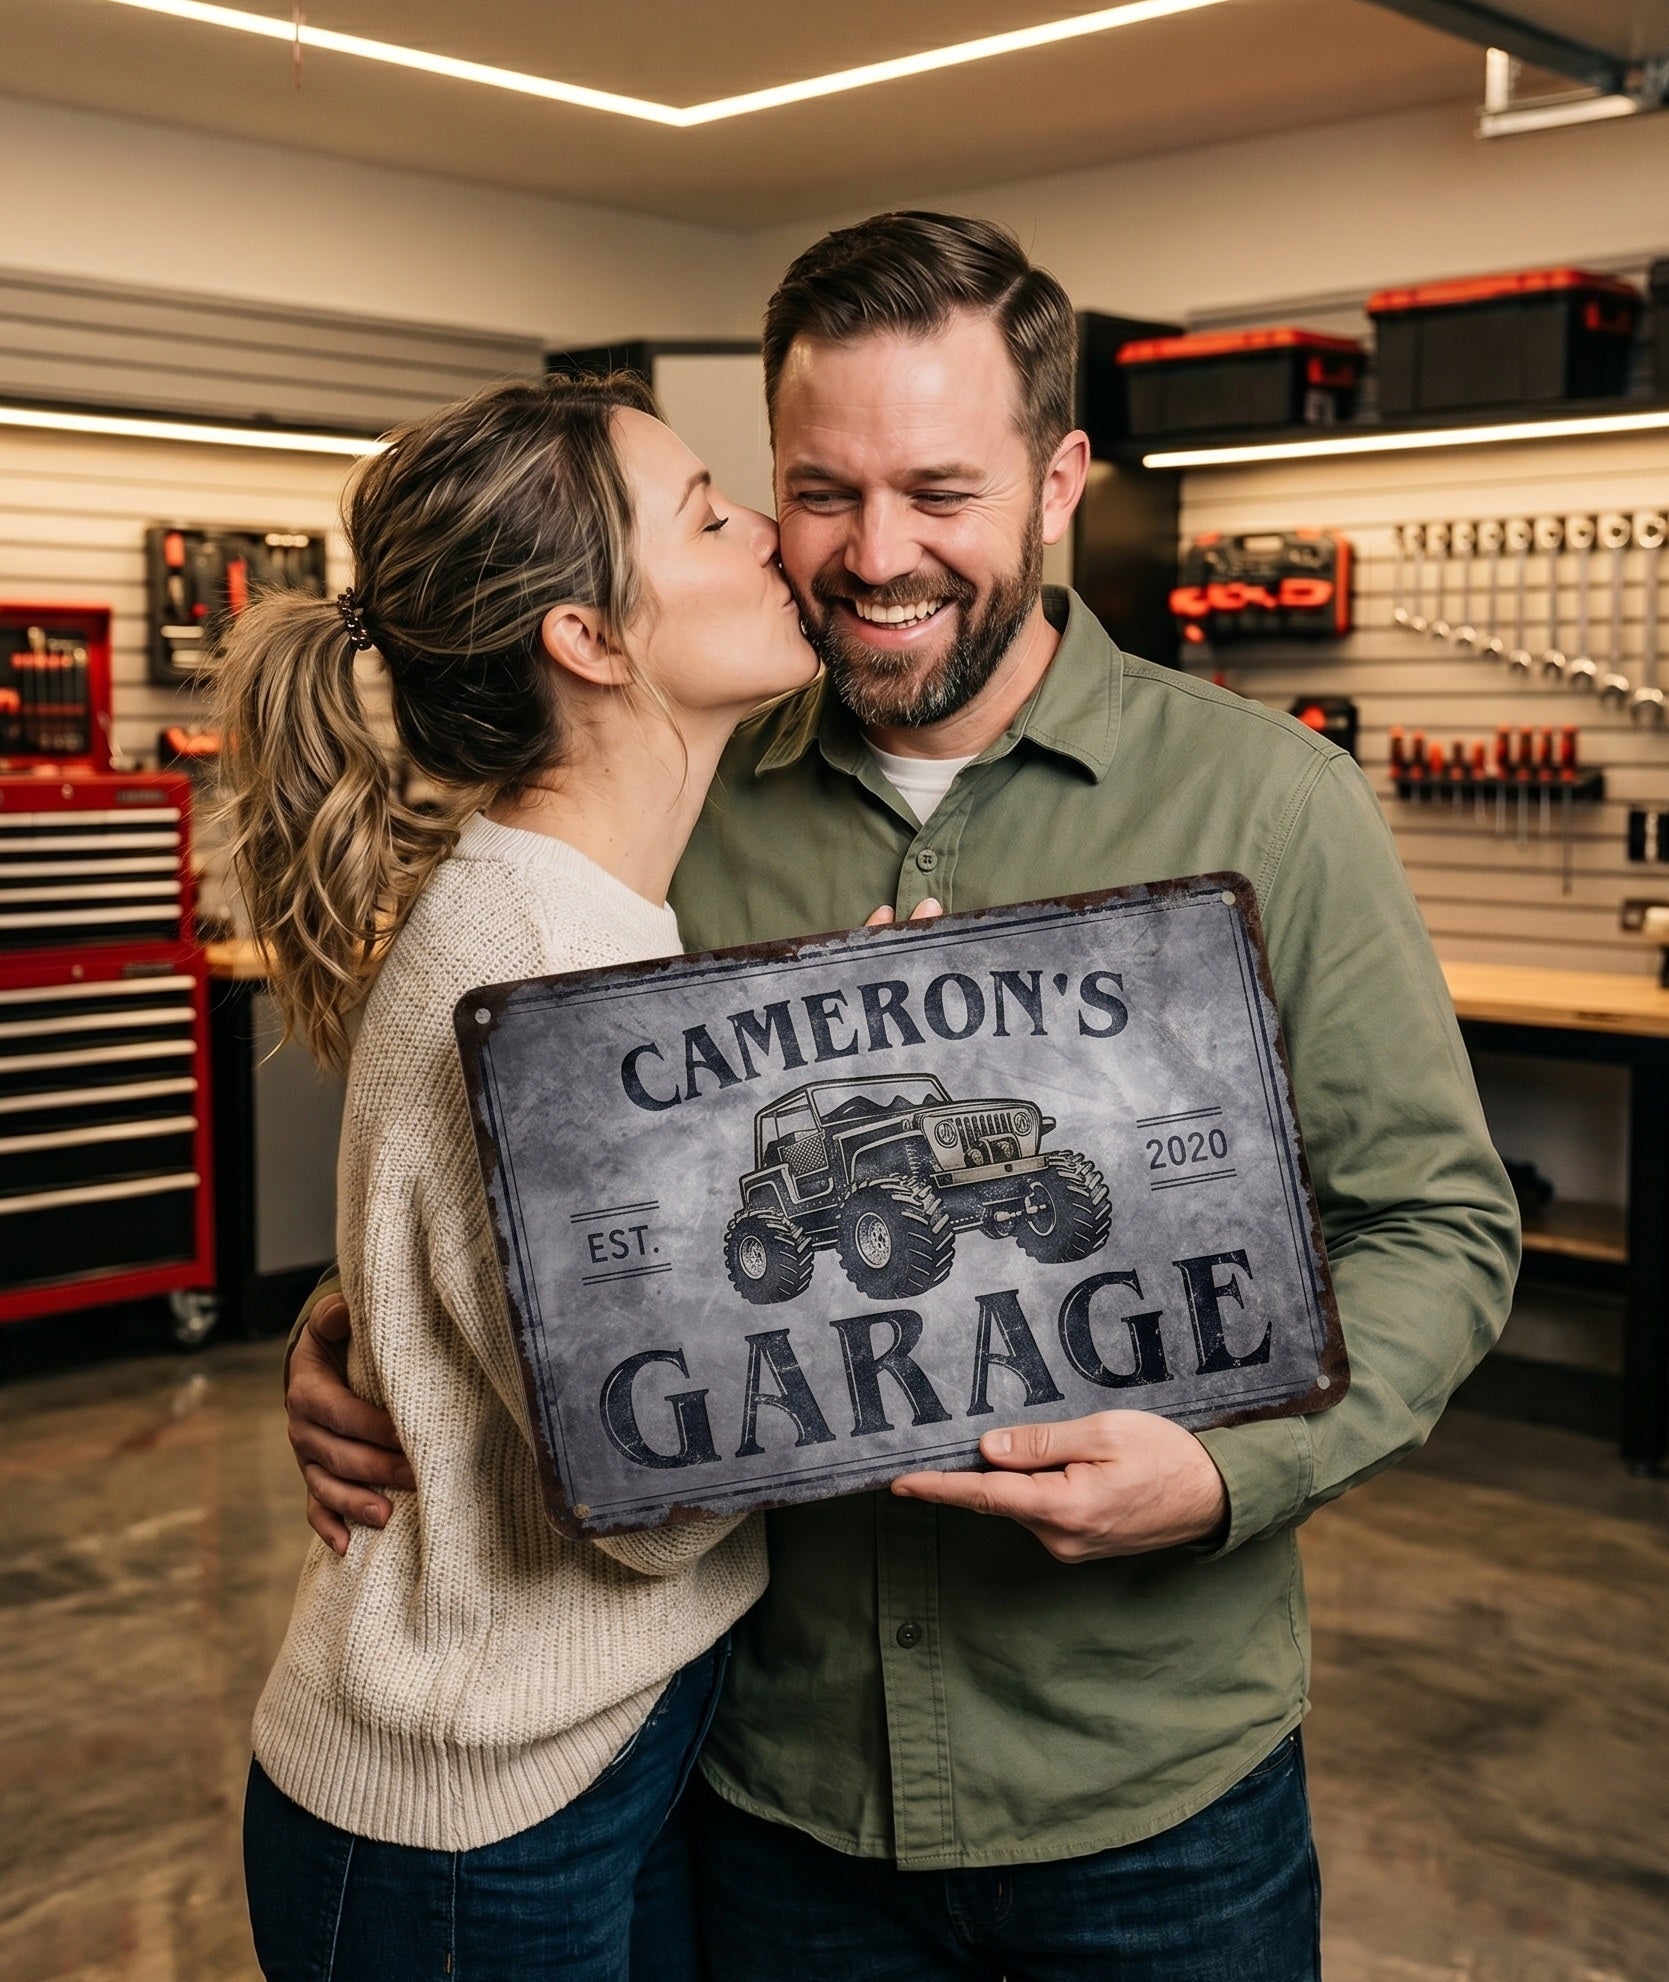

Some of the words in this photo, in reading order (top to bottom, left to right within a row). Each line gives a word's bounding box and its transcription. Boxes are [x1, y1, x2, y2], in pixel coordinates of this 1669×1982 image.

[620, 970, 1129, 1112] CAMERON'S
[587, 1223, 660, 1265] EST.
[1145, 1128, 1228, 1171] 2020
[600, 1248, 1272, 1470] GARAGE
